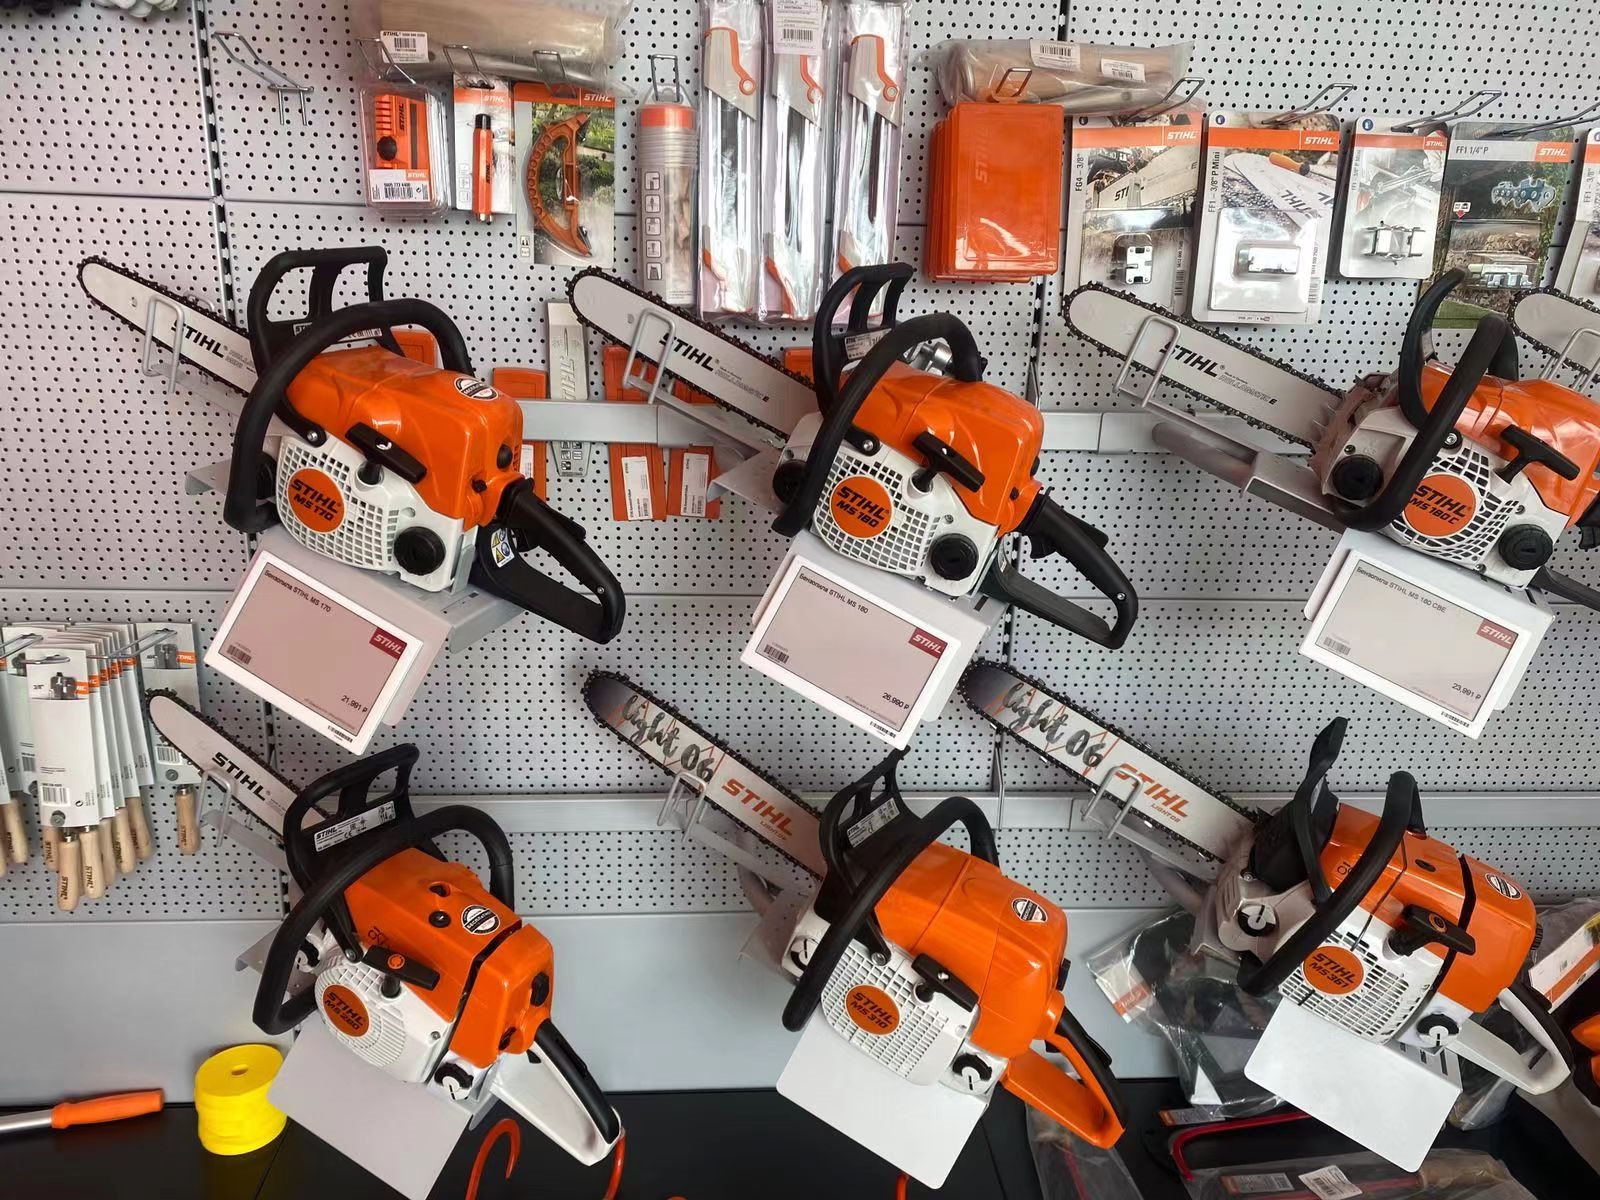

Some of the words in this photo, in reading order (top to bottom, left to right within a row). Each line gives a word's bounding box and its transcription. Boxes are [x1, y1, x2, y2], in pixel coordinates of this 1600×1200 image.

[584, 94, 612, 102] STIHL
[1167, 130, 1197, 140] STIHL
[1304, 136, 1334, 146] STIHL
[976, 128, 992, 183] STIHL
[1456, 146, 1468, 154] FF1
[1484, 146, 1488, 154] P
[1539, 148, 1566, 156] STIHL
[1075, 178, 1083, 192] FG4
[1208, 200, 1216, 213] FF1
[1212, 151, 1220, 170] Mini
[171, 320, 224, 358] STIHL
[659, 332, 714, 372] STIHL
[1160, 341, 1218, 378] STIHL
[290, 479, 338, 514] STIHL
[293, 495, 312, 510] MS
[312, 503, 334, 522] 170
[837, 486, 885, 520] STIHL
[1410, 497, 1428, 513] MS
[1414, 485, 1466, 518] STIHL
[836, 500, 857, 517] MS
[857, 510, 880, 529] 180
[293, 587, 309, 600] STIHL
[310, 597, 320, 605] MS
[320, 603, 331, 612] 170
[799, 573, 828, 593] Бензопила
[829, 590, 845, 602] STIHL
[847, 599, 857, 607] MS
[1389, 582, 1407, 595] STIHL
[1408, 592, 1419, 600] MS
[374, 634, 404, 654] STIHL
[912, 634, 942, 654] STIHL
[1481, 625, 1513, 644] STIHL
[1066, 728, 1106, 768] 06
[212, 752, 266, 801] STIHL
[681, 744, 715, 782] 06
[1114, 762, 1191, 819] STIHL
[722, 778, 793, 837] STIHL
[317, 827, 337, 839] STIHL
[60, 876, 68, 900] STIHL
[86, 866, 94, 888] STIHL
[1309, 963, 1328, 980] MS
[1328, 973, 1350, 988] 361
[1313, 952, 1356, 984] STIHL
[324, 1000, 341, 1017] MS
[326, 992, 364, 1027] STIHL
[851, 1002, 867, 1017] MS
[867, 1013, 889, 1029] 310
[853, 993, 893, 1024] STIHL
